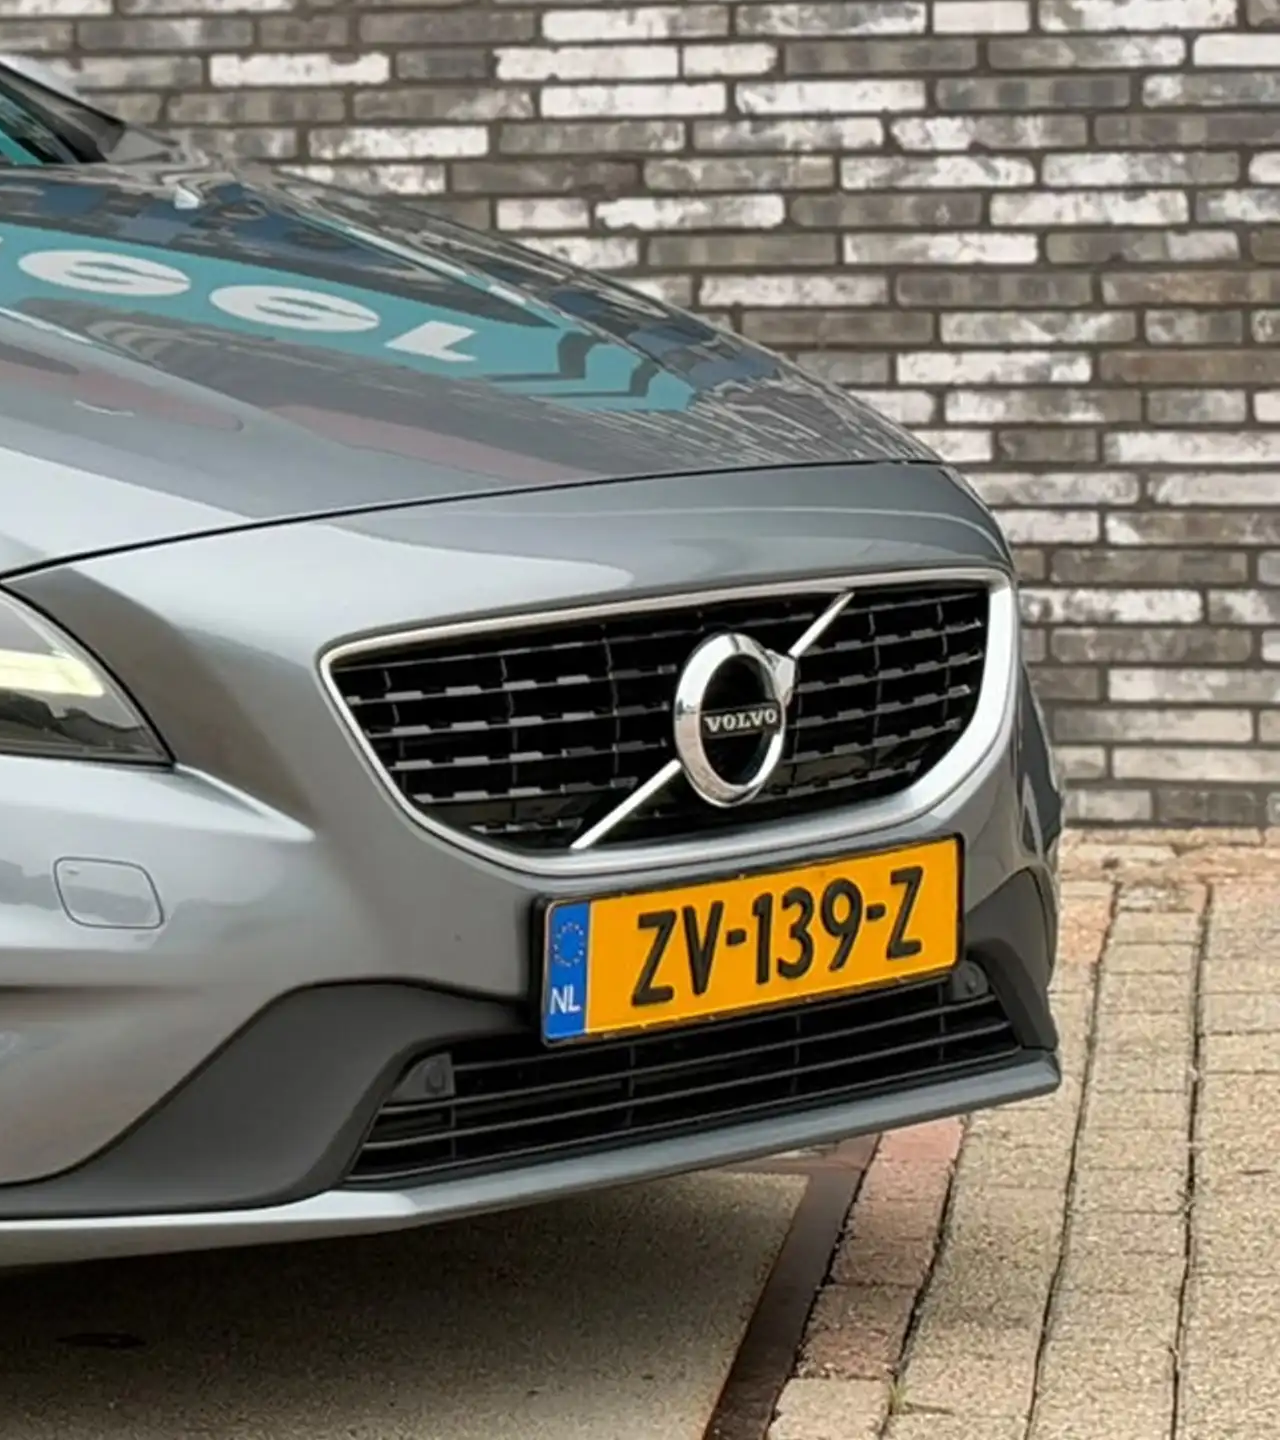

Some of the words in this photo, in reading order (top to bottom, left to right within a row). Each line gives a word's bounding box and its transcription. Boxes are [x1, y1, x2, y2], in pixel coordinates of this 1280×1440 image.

[704, 708, 778, 733] VOLVO
[549, 983, 581, 1015] NL
[630, 865, 924, 1008] ZV-139-Z
